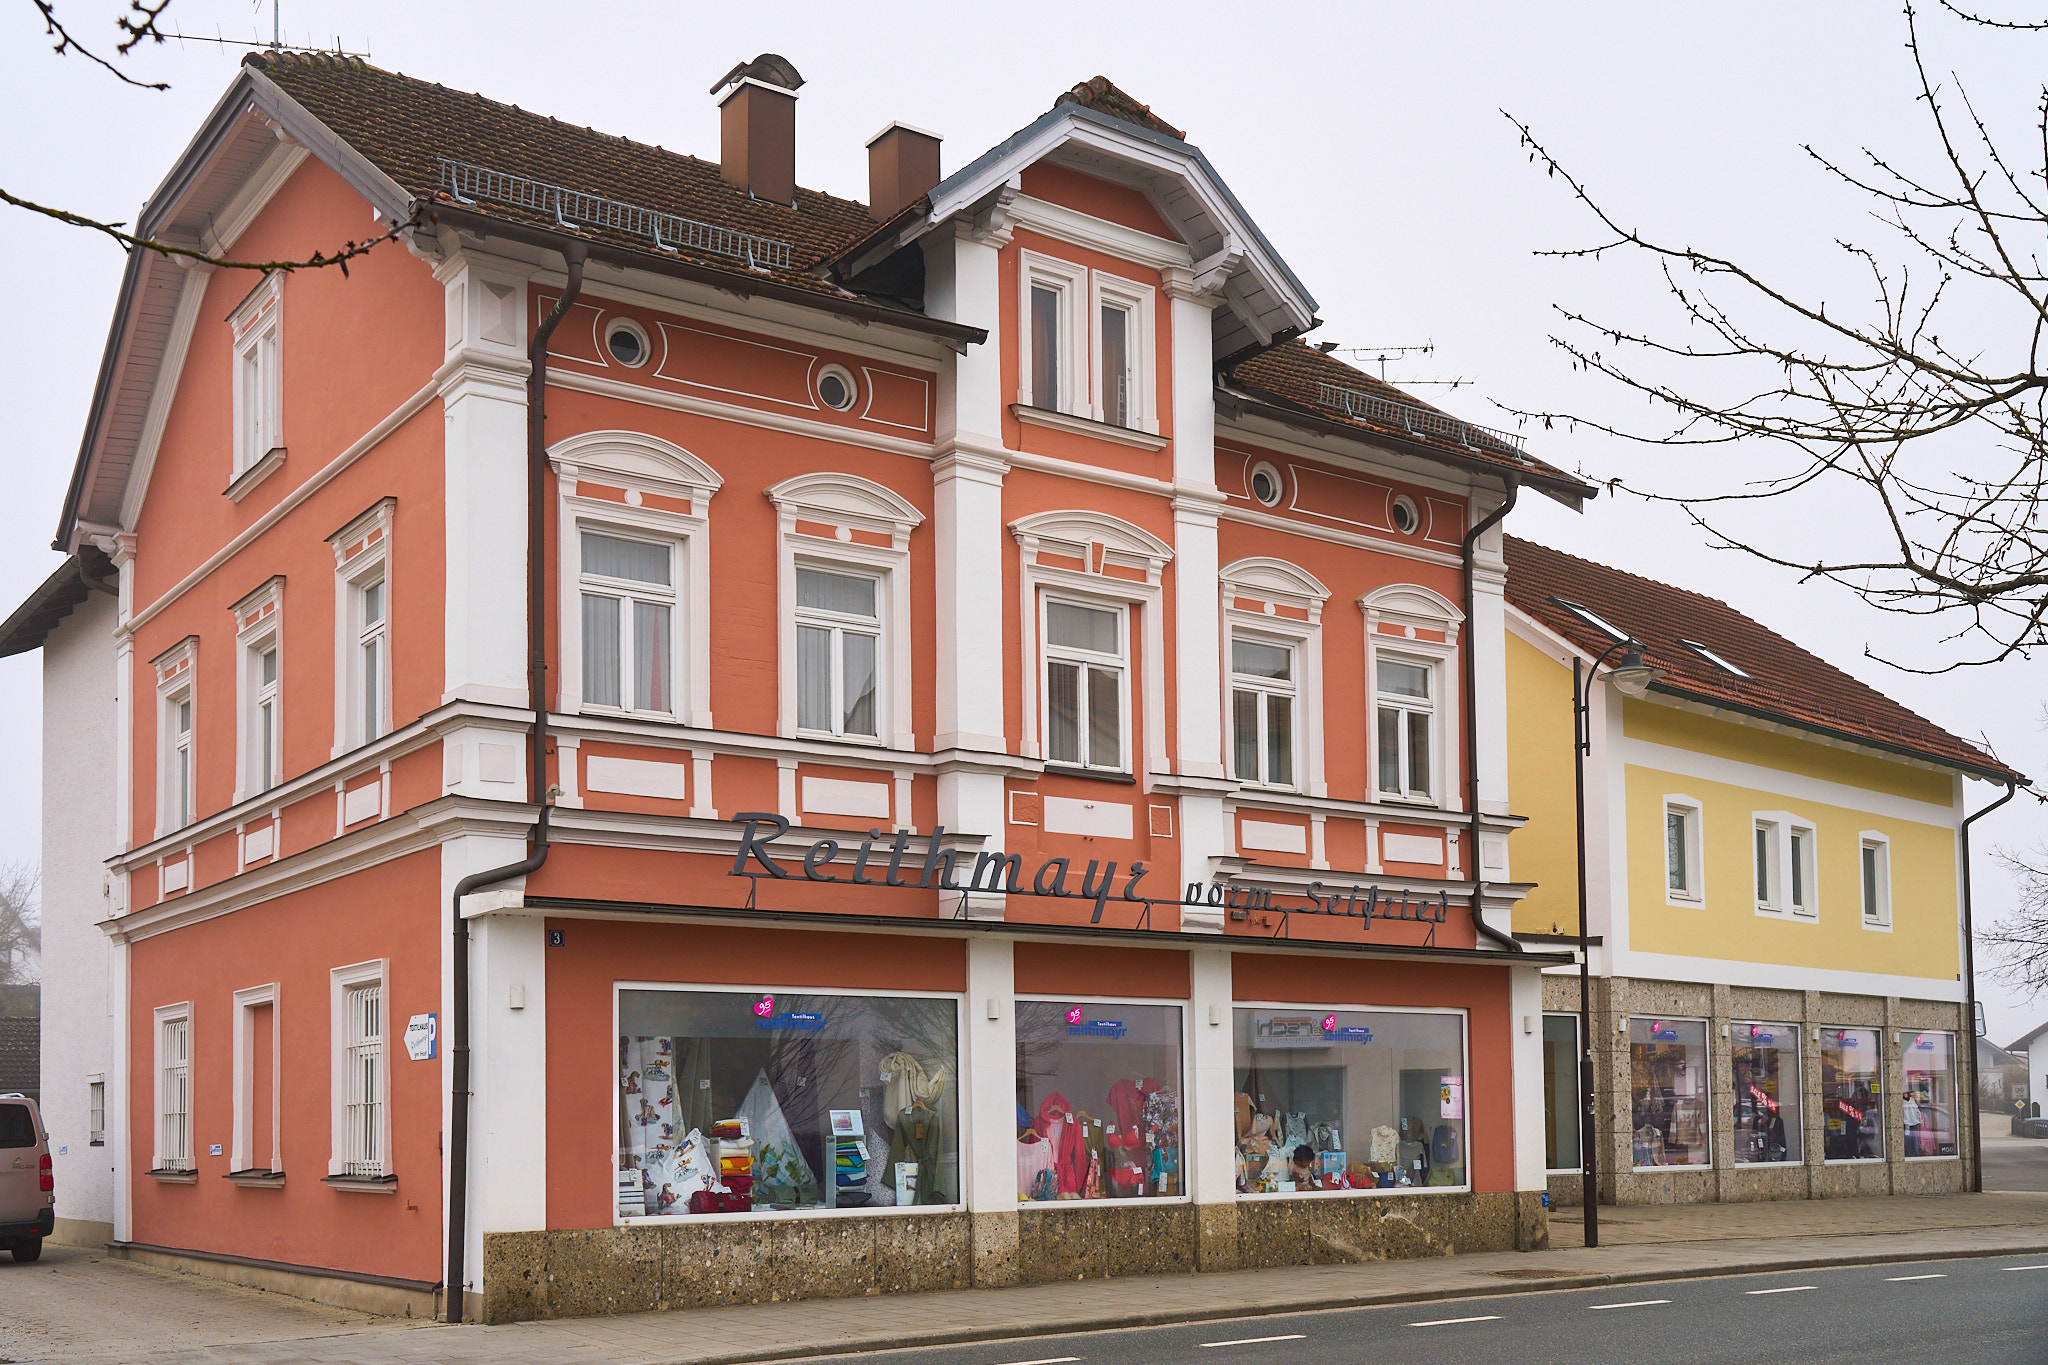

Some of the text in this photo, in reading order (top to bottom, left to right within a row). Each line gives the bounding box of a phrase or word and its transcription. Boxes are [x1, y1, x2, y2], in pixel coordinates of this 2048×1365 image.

[730, 812, 1449, 930] Reithmayr vorm. Seifried
[553, 932, 561, 945] 3
[758, 1000, 772, 1015] 95
[1069, 1008, 1080, 1023] 95
[756, 1012, 828, 1034] reithmayr
[1068, 1020, 1127, 1040] reithmayr
[1324, 1027, 1374, 1045] reithmayr
